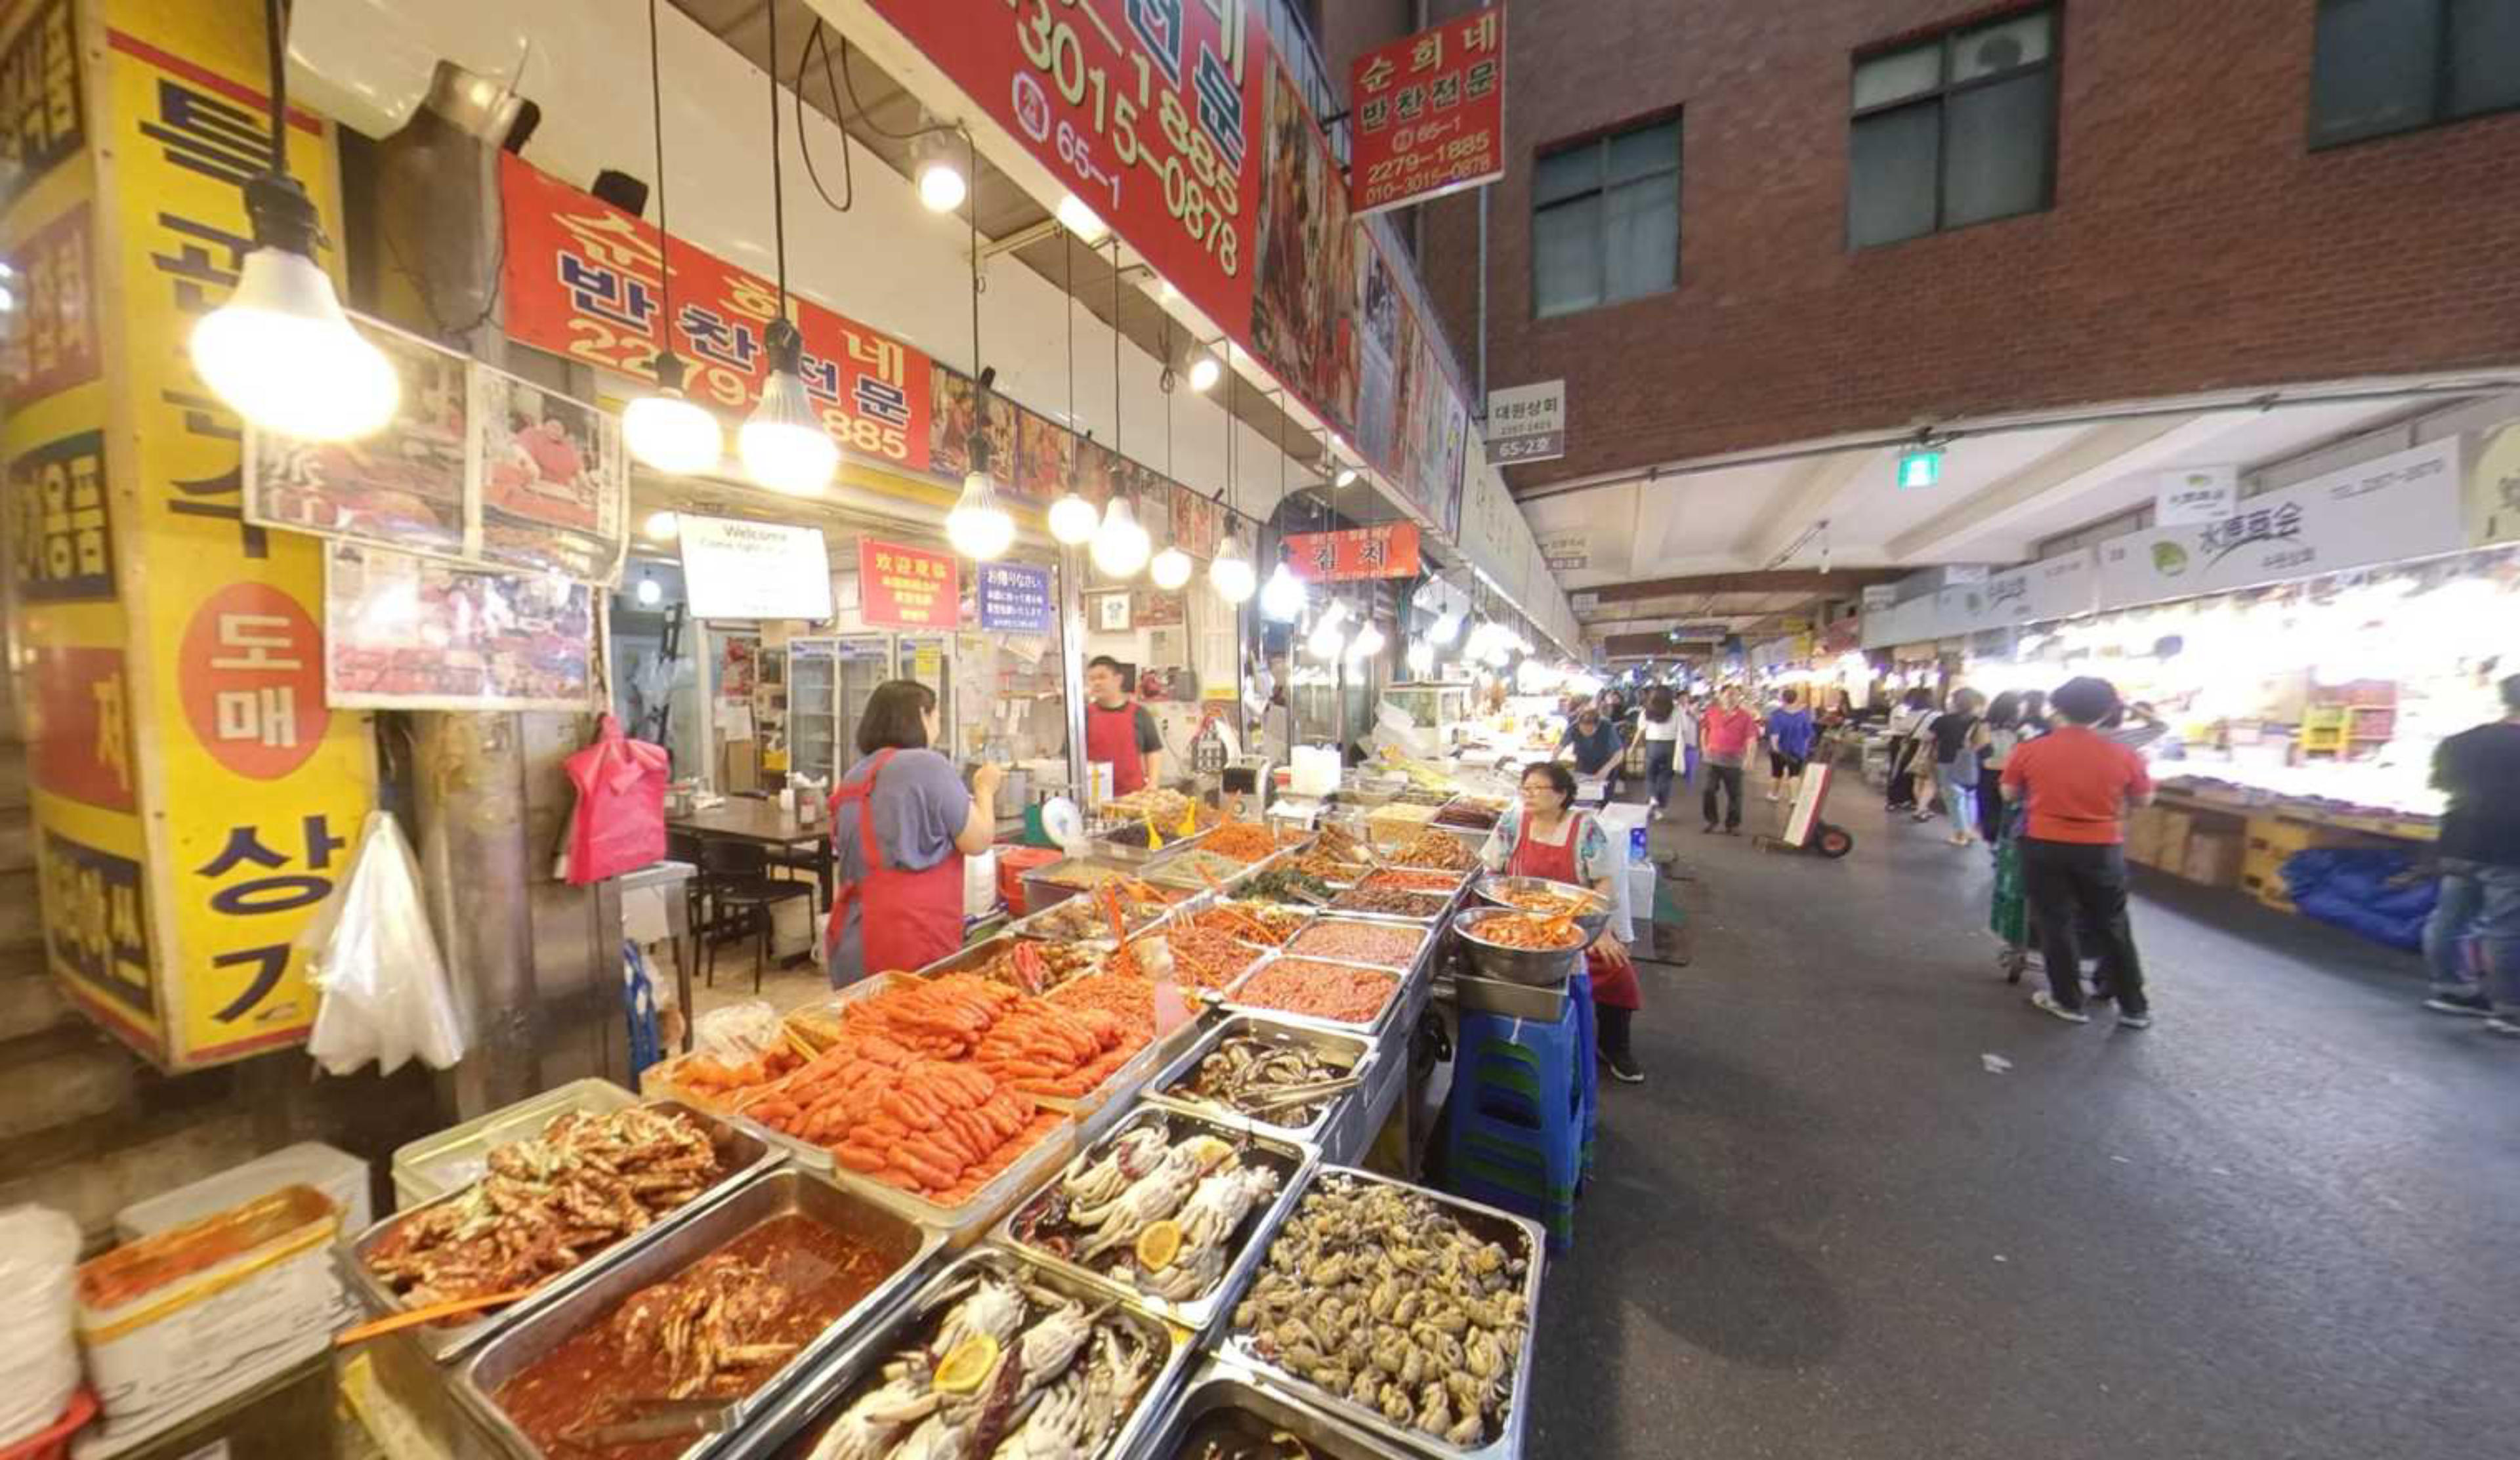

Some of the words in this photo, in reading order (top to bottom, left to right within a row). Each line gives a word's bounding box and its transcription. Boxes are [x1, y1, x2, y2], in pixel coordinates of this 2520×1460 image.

[1360, 59, 1498, 133] 반찬전문
[1056, 120, 1120, 211] 65-1
[1367, 129, 1490, 185] 2279-1885
[211, 611, 303, 748] 도매
